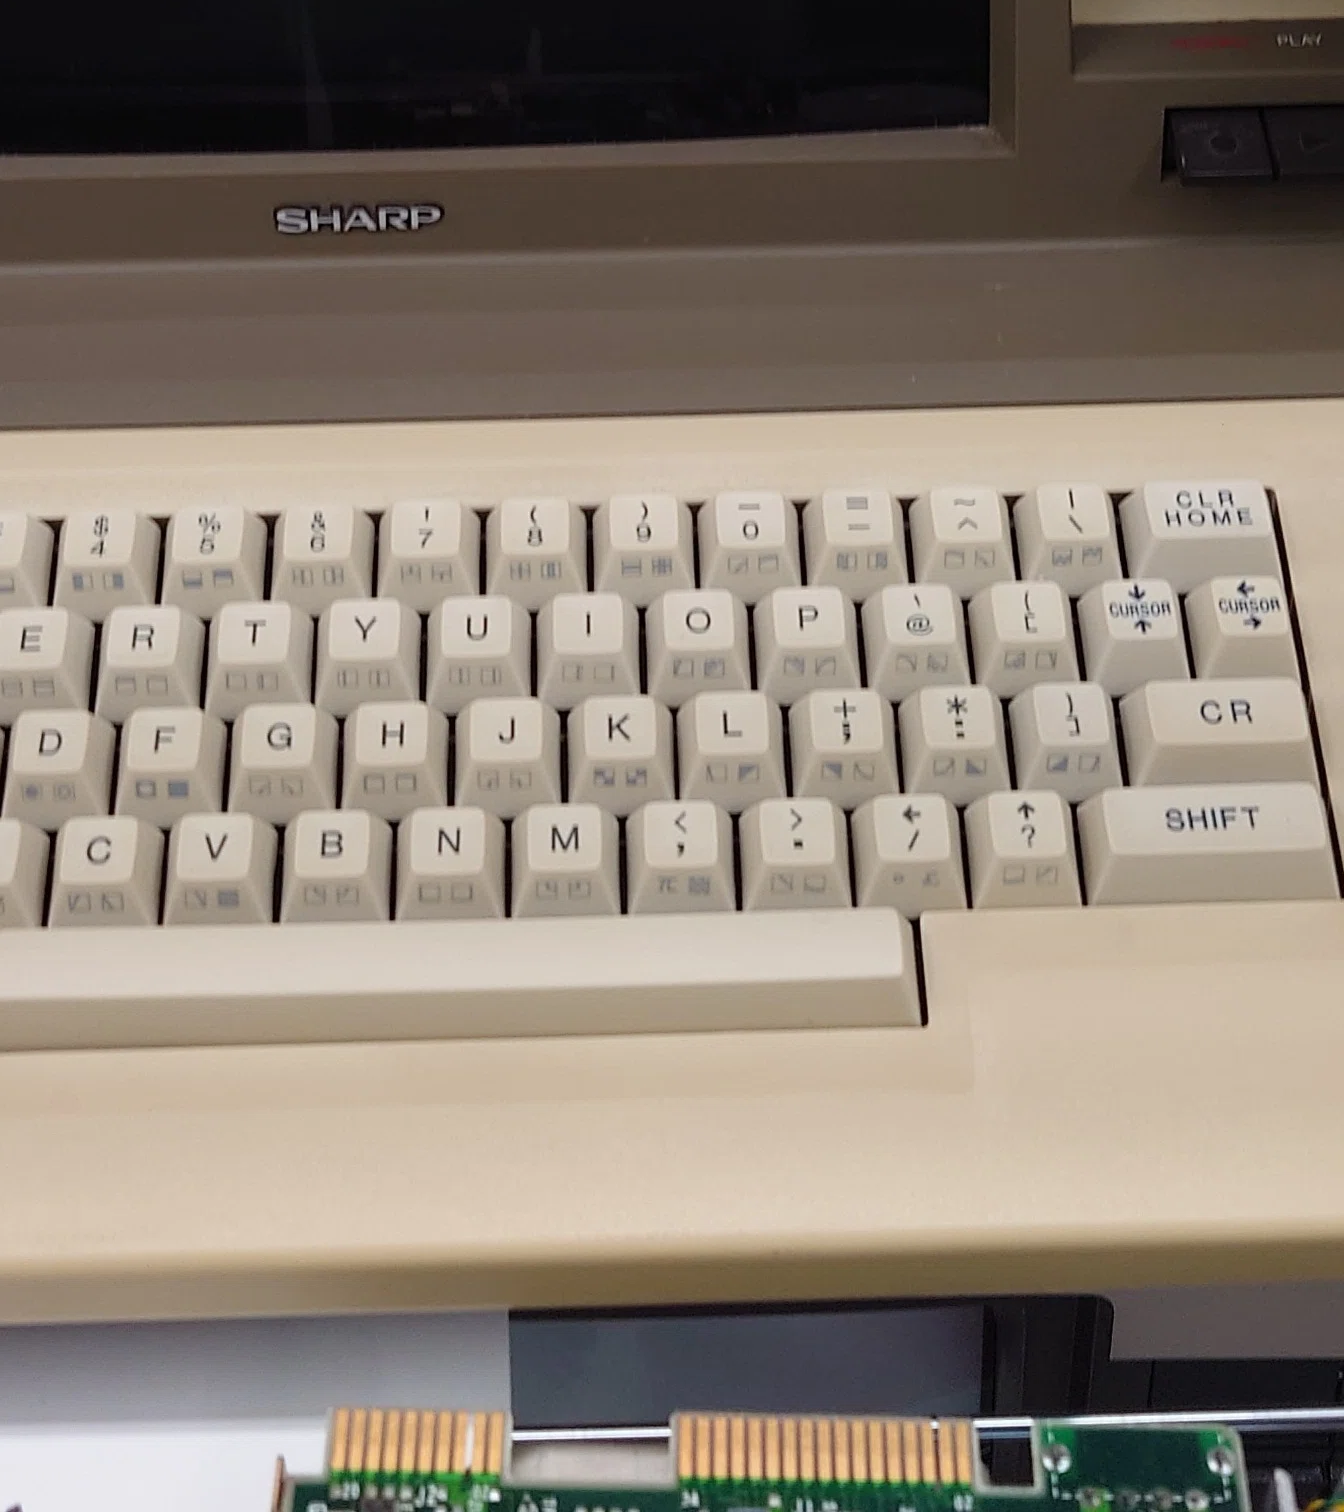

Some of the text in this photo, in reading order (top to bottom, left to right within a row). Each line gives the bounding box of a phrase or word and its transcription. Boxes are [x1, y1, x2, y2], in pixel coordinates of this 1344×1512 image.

[1277, 33, 1323, 48] PLAY
[275, 205, 444, 235] SHARP
[1177, 491, 1234, 508] CLR
[94, 516, 108, 537] $
[199, 514, 221, 533] %
[311, 513, 325, 533] &
[958, 517, 978, 530] ^
[1069, 515, 1083, 533] \
[1165, 510, 1255, 526] HOME
[200, 536, 214, 553] 5
[310, 534, 325, 551] 6
[420, 529, 432, 548] 7
[528, 524, 543, 545] 8
[637, 525, 651, 541] 9
[91, 540, 104, 556] 4
[1109, 602, 1171, 617] CURSOR
[1219, 597, 1280, 613] CURSOR
[355, 617, 376, 642] Y
[467, 616, 487, 639] U
[686, 606, 711, 633] O
[799, 607, 818, 630] P
[906, 614, 933, 637] @
[20, 627, 44, 651] E
[132, 626, 154, 649] R
[244, 621, 266, 645] T
[835, 699, 855, 720] +
[1200, 701, 1252, 725] CR
[382, 722, 404, 747] H
[498, 718, 515, 743] J
[608, 715, 630, 740] K
[723, 712, 741, 737] L
[39, 731, 62, 754] D
[154, 728, 176, 753] F
[267, 724, 292, 750] G
[674, 811, 687, 834] <
[790, 808, 802, 831] >
[1166, 807, 1258, 831] SHIFT
[206, 834, 227, 860] V
[321, 832, 343, 857] B
[438, 828, 460, 854] N
[552, 826, 579, 852] M
[908, 830, 919, 851] /
[1021, 825, 1035, 848] ?
[87, 837, 111, 864] C
